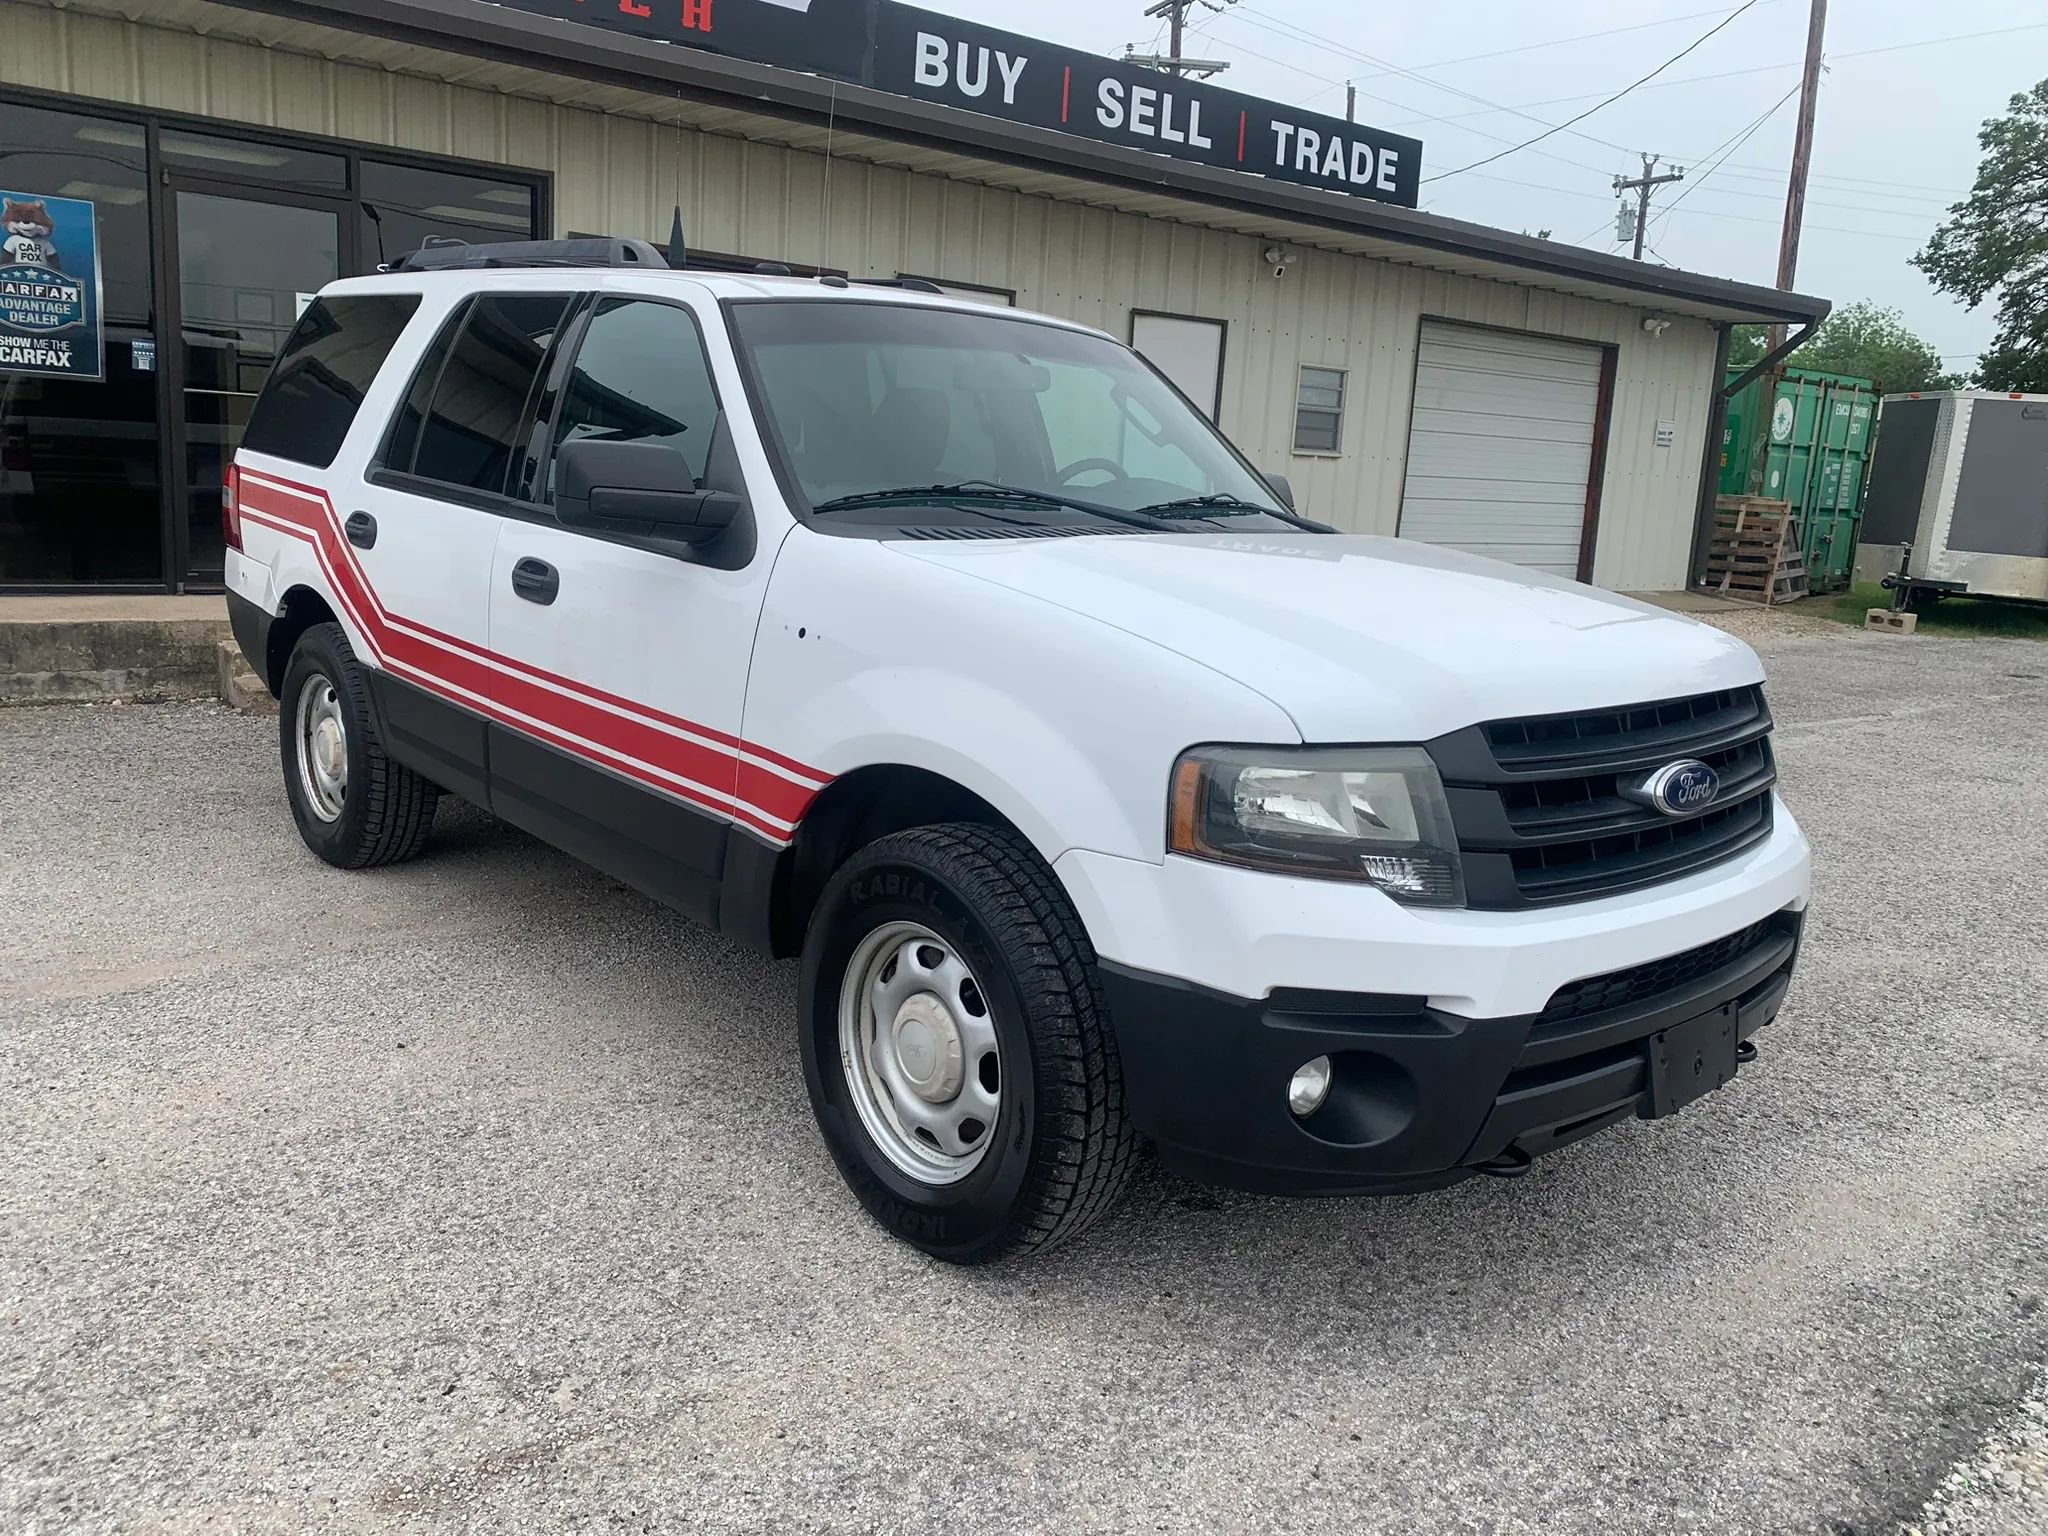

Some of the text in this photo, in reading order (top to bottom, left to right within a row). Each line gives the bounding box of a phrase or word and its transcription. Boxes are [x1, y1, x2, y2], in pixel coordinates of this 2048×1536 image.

[914, 31, 1400, 192] BUY SELL TRADE
[19, 243, 42, 253] CAR
[20, 252, 42, 262] FOX
[2, 282, 77, 302] ARFAX
[9, 310, 59, 326] DEALER
[33, 338, 49, 350] ME
[51, 339, 70, 351] THE
[0, 346, 72, 367] CARFAX
[1678, 771, 1712, 804] Ford
[849, 873, 943, 916] RADIAL
